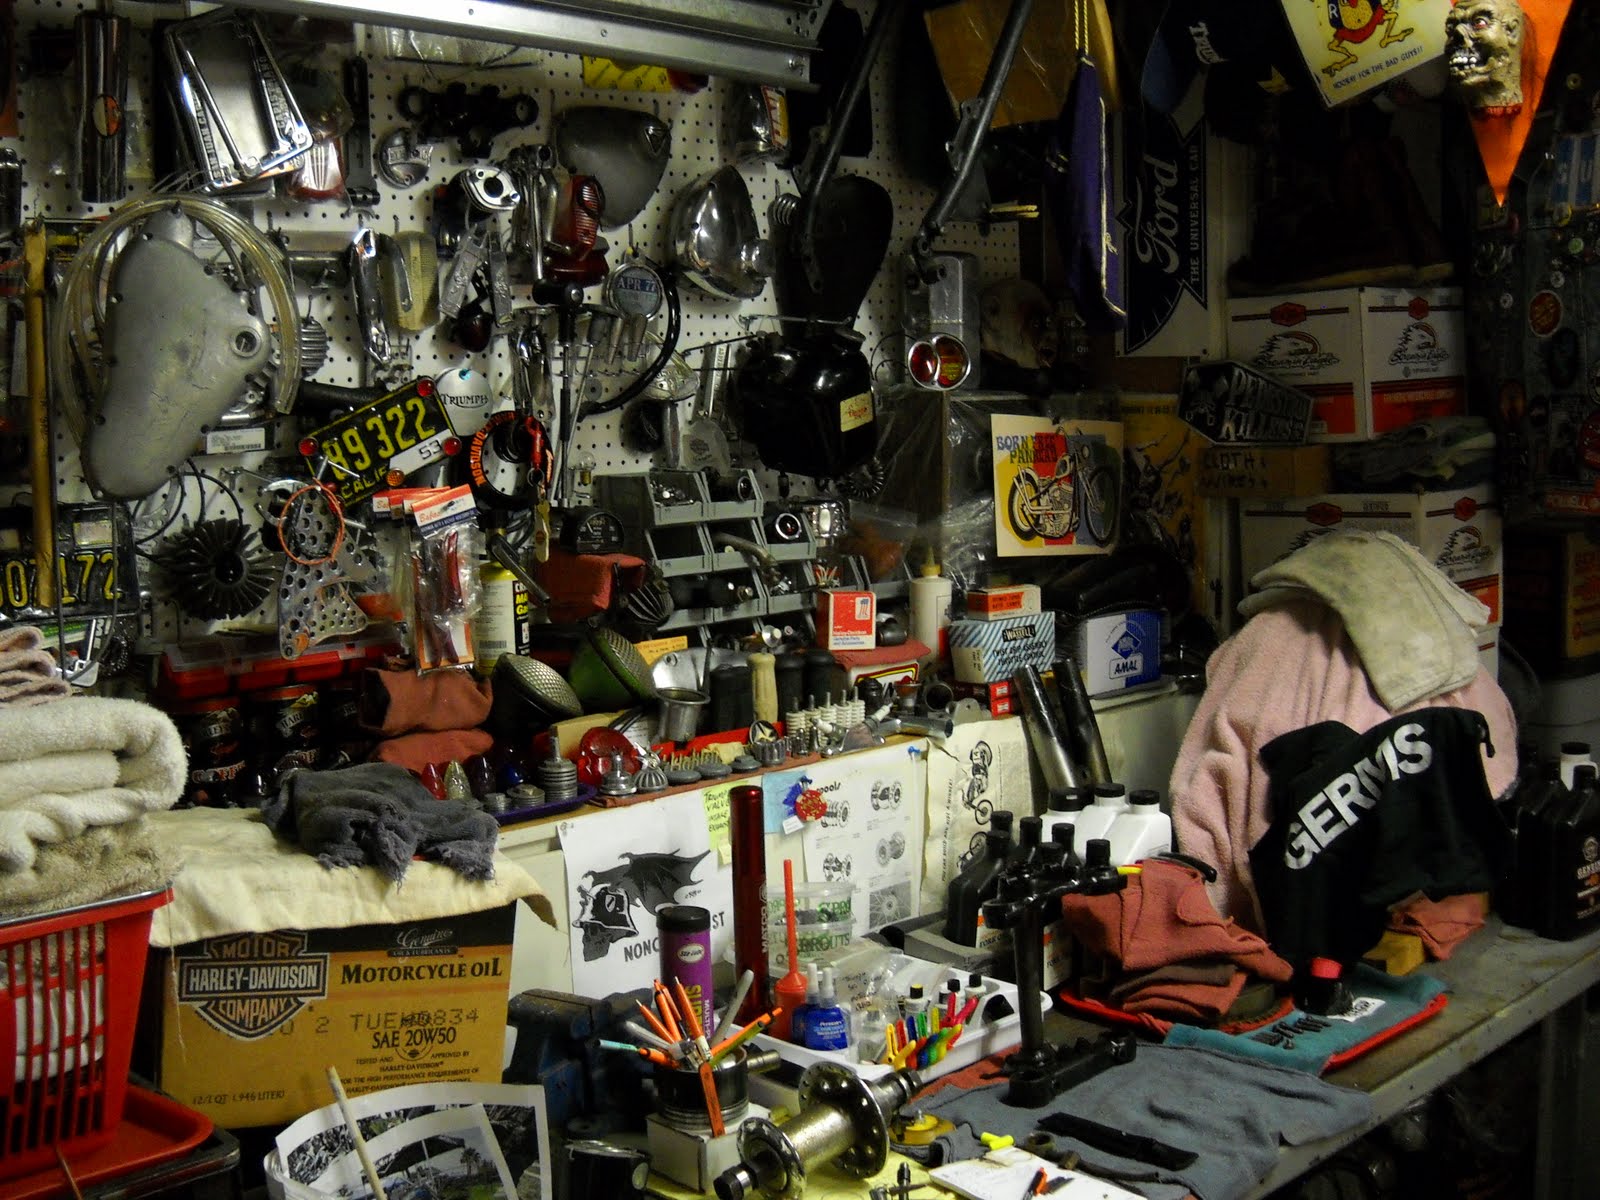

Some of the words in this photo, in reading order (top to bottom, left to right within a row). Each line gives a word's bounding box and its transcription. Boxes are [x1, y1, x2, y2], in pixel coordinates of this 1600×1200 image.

[1358, 70, 1370, 79] FOR
[1371, 63, 1384, 75] THE
[1385, 56, 1400, 69] BAD
[1188, 145, 1201, 171] CAR
[1134, 152, 1180, 274] Ford
[1188, 176, 1201, 251] UNIVERSAL
[1189, 257, 1201, 283] THE
[617, 277, 640, 291] APR
[440, 393, 489, 406] TRIUMPH
[419, 439, 442, 460] 53
[996, 435, 1028, 450] BORN
[1114, 660, 1138, 675] AMAL
[1282, 722, 1433, 871] GERMS
[222, 937, 290, 959] MOTOR
[189, 965, 318, 992] HARLEY-DAVIDSON
[340, 962, 467, 986] MOTORCYCLE
[471, 957, 503, 978] OIL
[218, 997, 289, 1029] COMPANY
[350, 1011, 397, 1032] TUE
[372, 1032, 400, 1049] SAE
[405, 1026, 457, 1047] 20W50
[356, 1057, 377, 1065] TESTED
[430, 1051, 461, 1060] APPROVED
[366, 1075, 382, 1083] HIGH
[383, 1071, 426, 1082] PERFORMANCE
[427, 1068, 470, 1079] REQUIREMENTS
